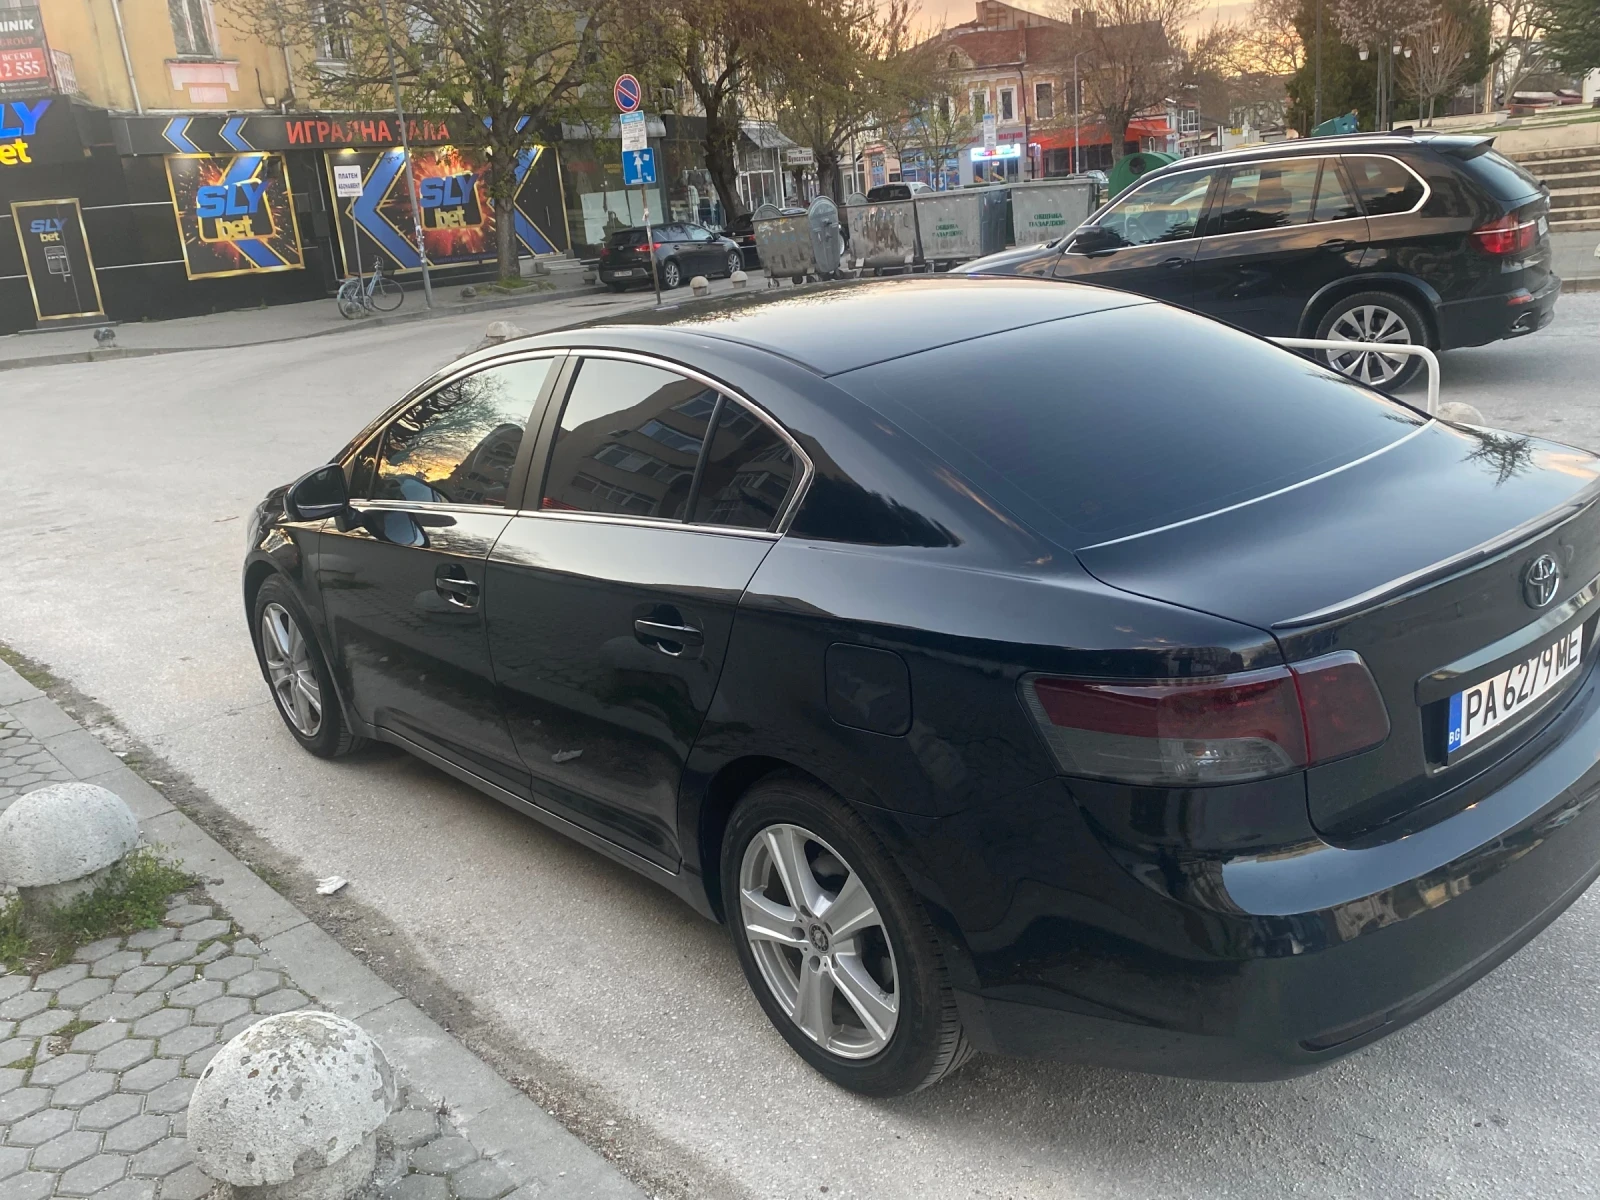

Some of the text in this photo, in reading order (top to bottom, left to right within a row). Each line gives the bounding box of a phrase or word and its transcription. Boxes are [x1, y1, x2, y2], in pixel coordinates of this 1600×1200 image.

[16, 61, 41, 76] 555
[196, 180, 271, 218] SLY
[420, 173, 479, 208] SLY
[30, 217, 68, 233] SLY
[215, 215, 254, 240] bet
[434, 206, 467, 229] bet
[40, 232, 60, 242] bet
[1465, 632, 1578, 737] PA 6279 ME
[1449, 728, 1461, 745] BG
